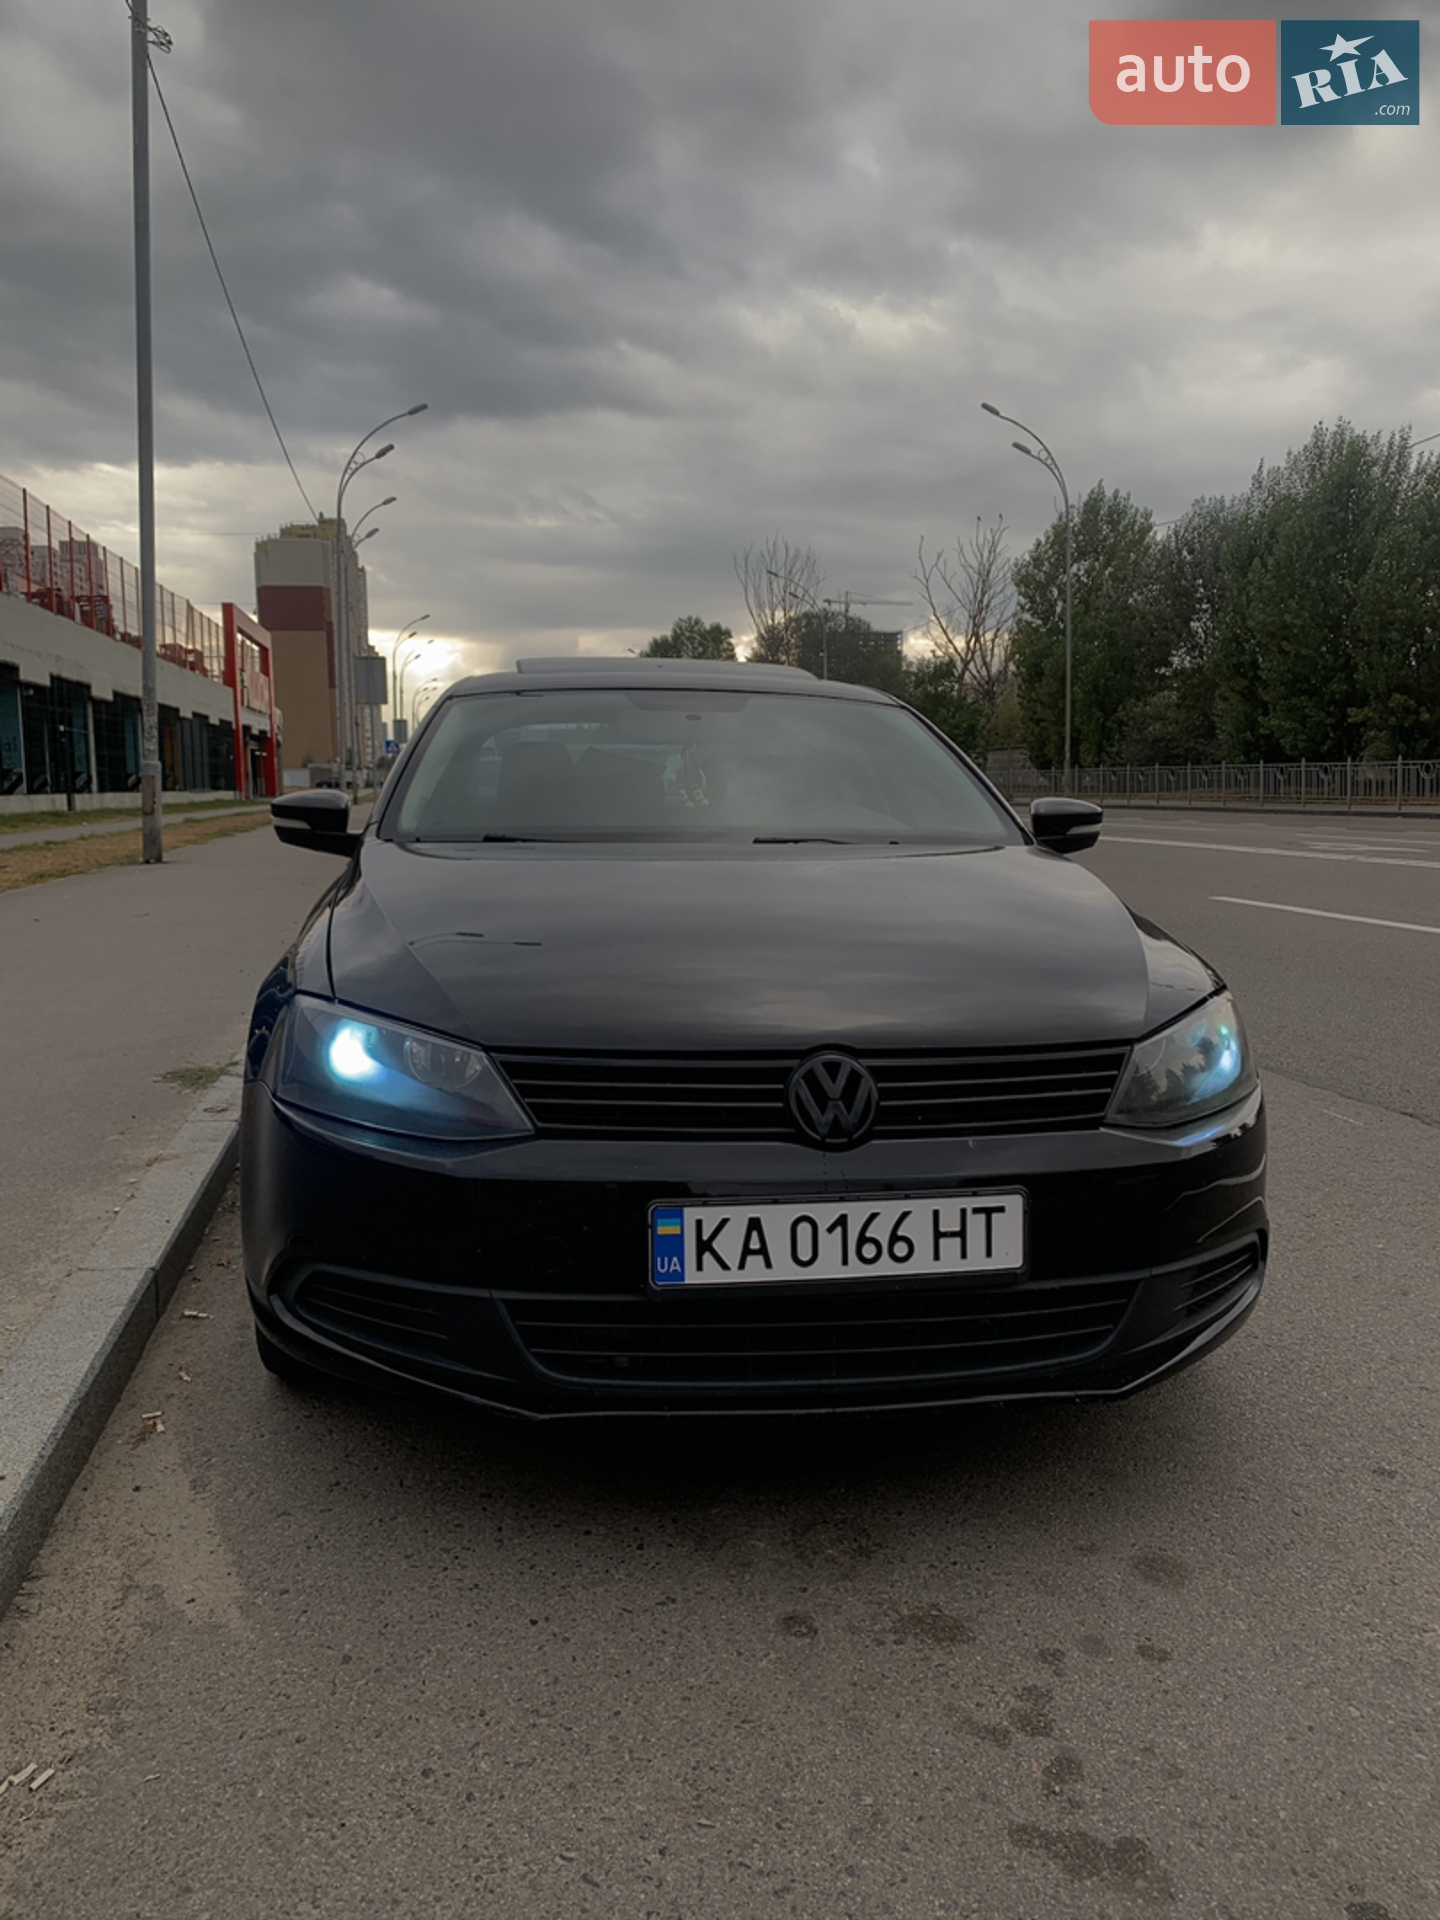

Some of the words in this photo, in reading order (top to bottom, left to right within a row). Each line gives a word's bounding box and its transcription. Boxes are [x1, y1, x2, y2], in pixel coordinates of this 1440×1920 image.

[694, 1215, 773, 1272] KA
[789, 1209, 915, 1268] 0166
[931, 1204, 1006, 1262] HT
[656, 1256, 682, 1274] UA
